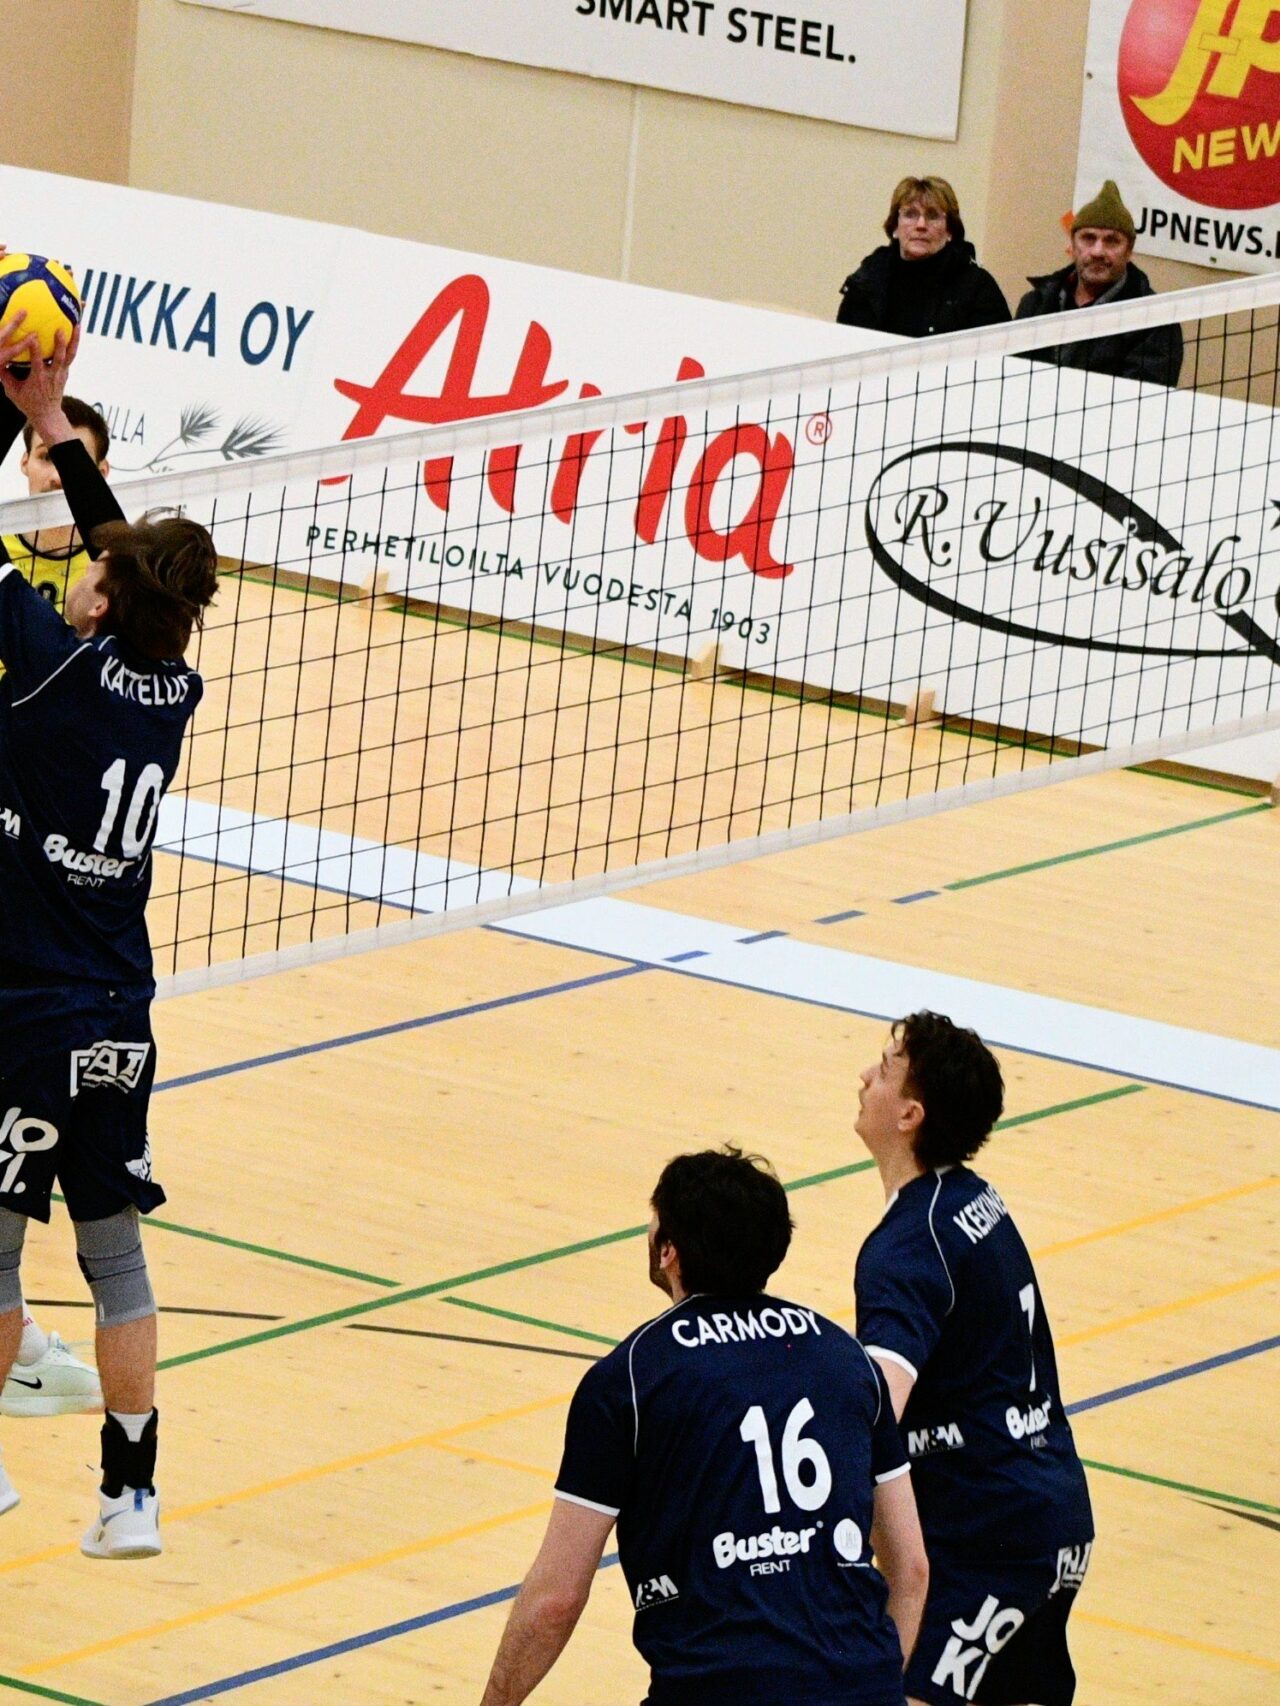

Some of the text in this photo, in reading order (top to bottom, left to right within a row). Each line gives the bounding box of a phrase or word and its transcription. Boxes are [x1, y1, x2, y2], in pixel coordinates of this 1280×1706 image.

[726, 7, 856, 63] STEEL.
[1135, 207, 1280, 259] JPNEWS.
[241, 301, 314, 371] OY
[320, 274, 794, 579] Atria
[894, 485, 952, 568] R.
[306, 525, 772, 645] PERHETILOILTA VUODESTA 1903
[92, 758, 165, 858] 10
[42, 833, 136, 879] Buster
[67, 873, 106, 888] RENT
[671, 1308, 822, 1347] CARMODY
[739, 1397, 832, 1514] 16
[713, 1525, 816, 1568] Buster
[750, 1559, 791, 1577] RENT
